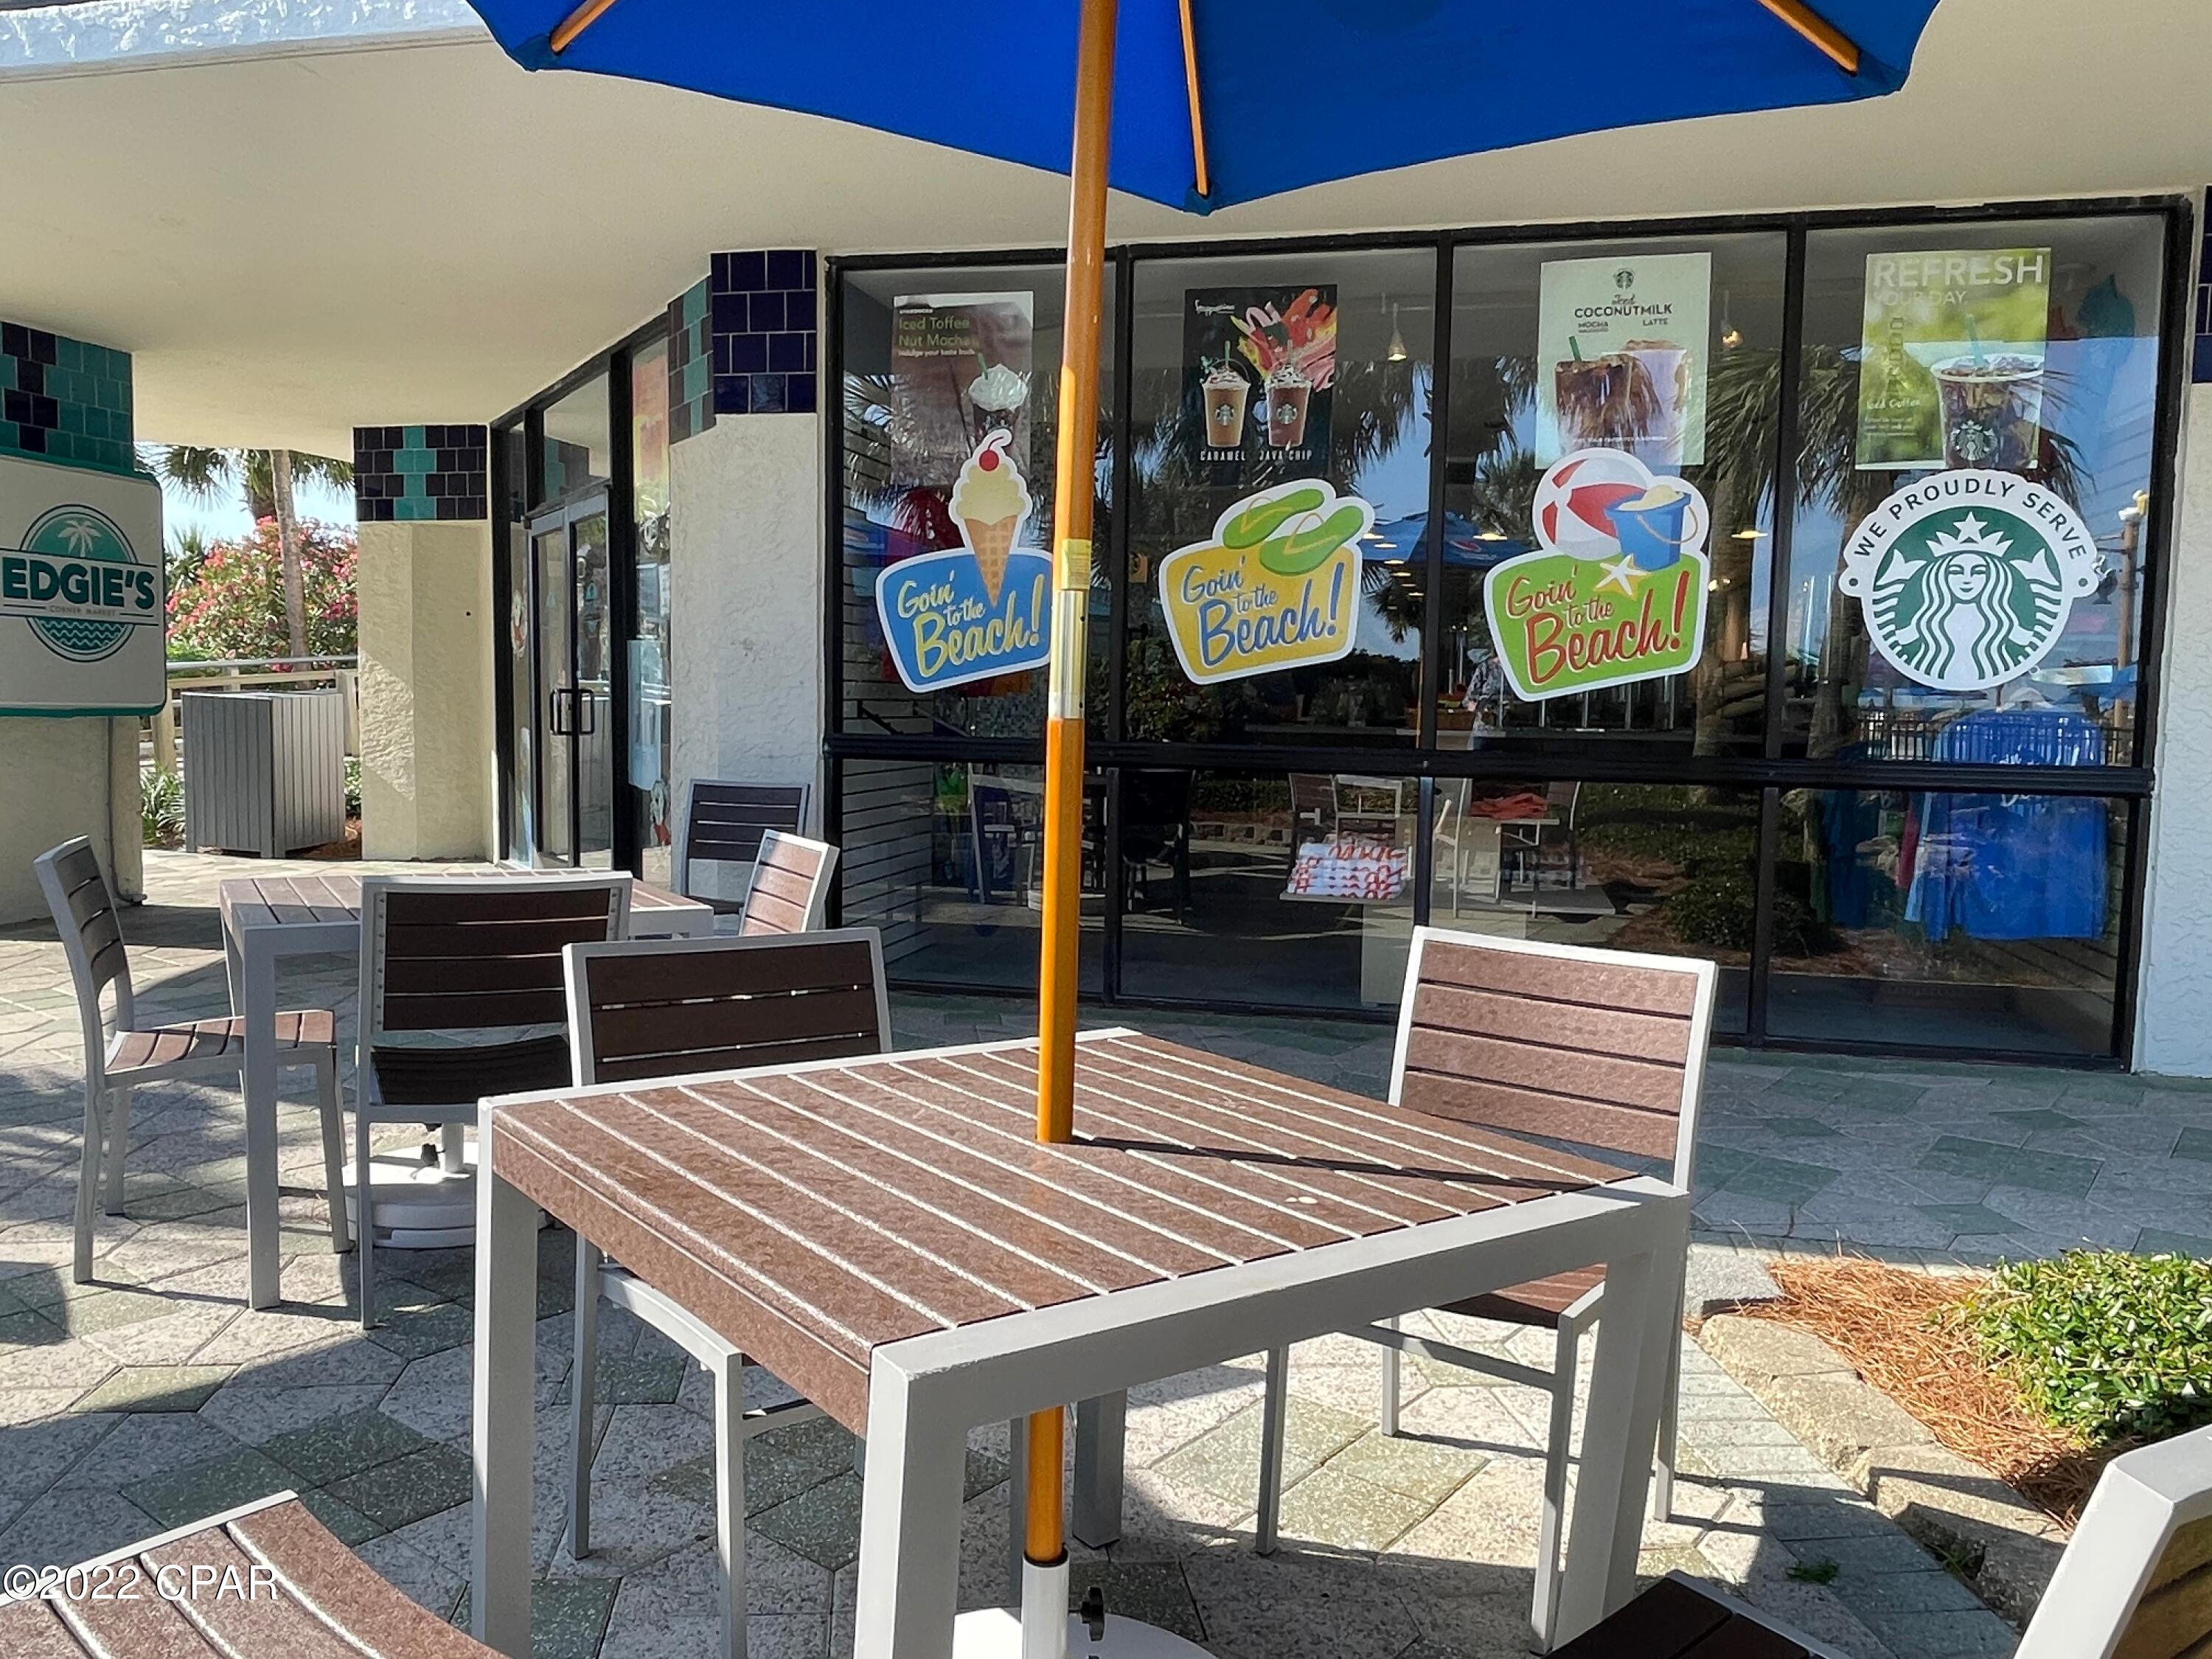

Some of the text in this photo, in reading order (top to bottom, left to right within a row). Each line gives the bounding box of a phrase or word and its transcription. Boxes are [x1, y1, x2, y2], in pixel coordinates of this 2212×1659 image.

[1873, 255, 2043, 287] REFRESH
[1575, 303, 1673, 318] COCONUTMILK
[1929, 290, 1967, 305] DAY
[899, 315, 970, 330] Iced Toffee
[1643, 318, 1668, 326] LATTE
[899, 335, 923, 347] Nut
[1200, 451, 1245, 461] CARAMEL
[1854, 478, 2087, 560] WE PROUDLY SERVE
[2, 557, 156, 610] EDGIE'S
[897, 569, 955, 618] Goin'
[1182, 555, 1245, 605] Goin'
[1506, 564, 1578, 618] Goin'
[943, 595, 986, 627] to the
[1233, 582, 1279, 615] to the
[1563, 594, 1615, 628] to the
[913, 574, 1045, 678] Beach!
[1197, 562, 1344, 669] Beach!
[1525, 570, 1690, 686] Beach!
